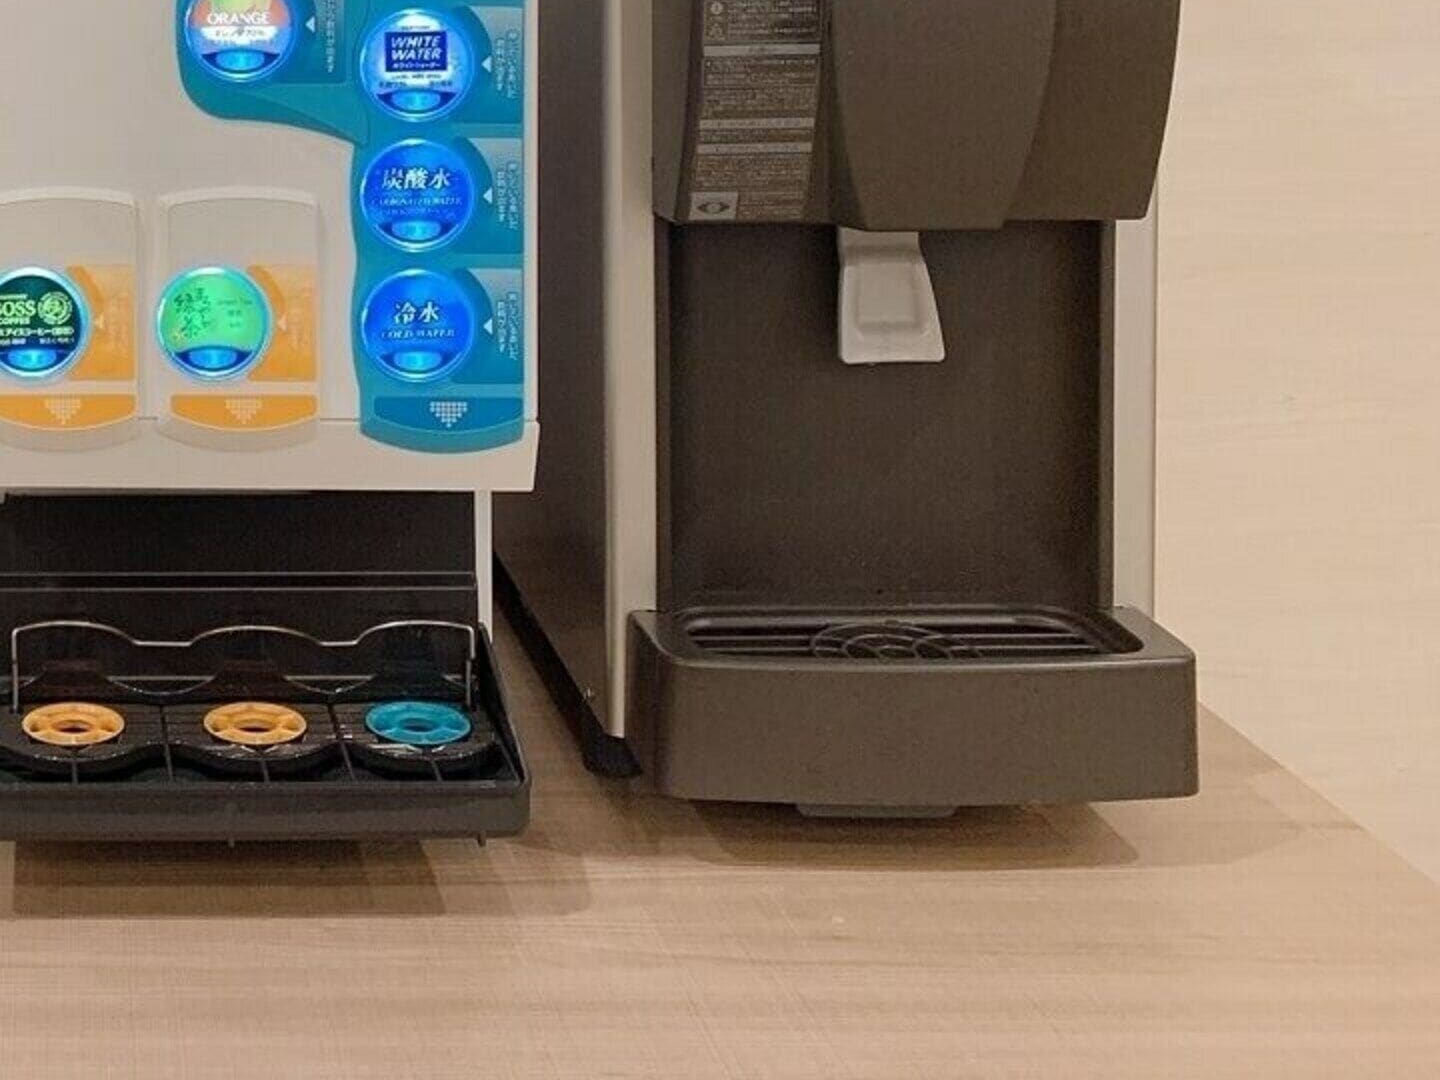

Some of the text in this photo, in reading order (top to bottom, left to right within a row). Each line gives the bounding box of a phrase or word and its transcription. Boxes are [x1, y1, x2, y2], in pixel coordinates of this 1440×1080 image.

[207, 11, 272, 26] ORANGE
[391, 35, 441, 47] WHITE
[391, 48, 443, 60] WATER
[382, 167, 452, 190] 炭酸水
[394, 301, 440, 325] 冷水
